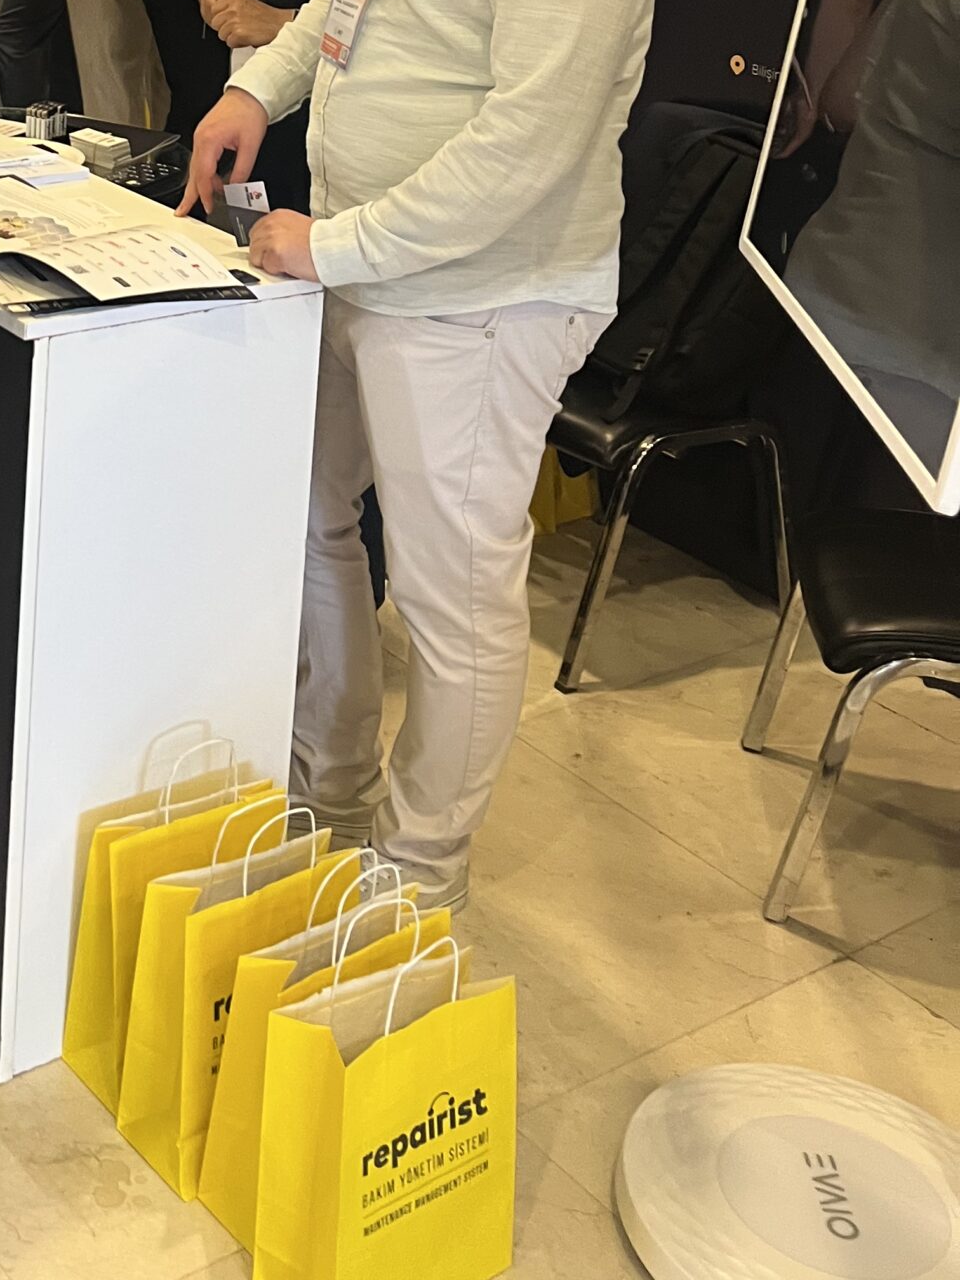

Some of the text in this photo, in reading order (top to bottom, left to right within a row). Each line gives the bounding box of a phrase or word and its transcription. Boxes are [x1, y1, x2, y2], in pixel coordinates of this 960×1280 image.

[362, 1087, 489, 1178] repairist
[362, 1179, 395, 1209] BAKIM
[399, 1152, 444, 1189] YÖNETİM
[363, 1159, 489, 1238] MAINTENANCE MANAGEMENT SYSTEM
